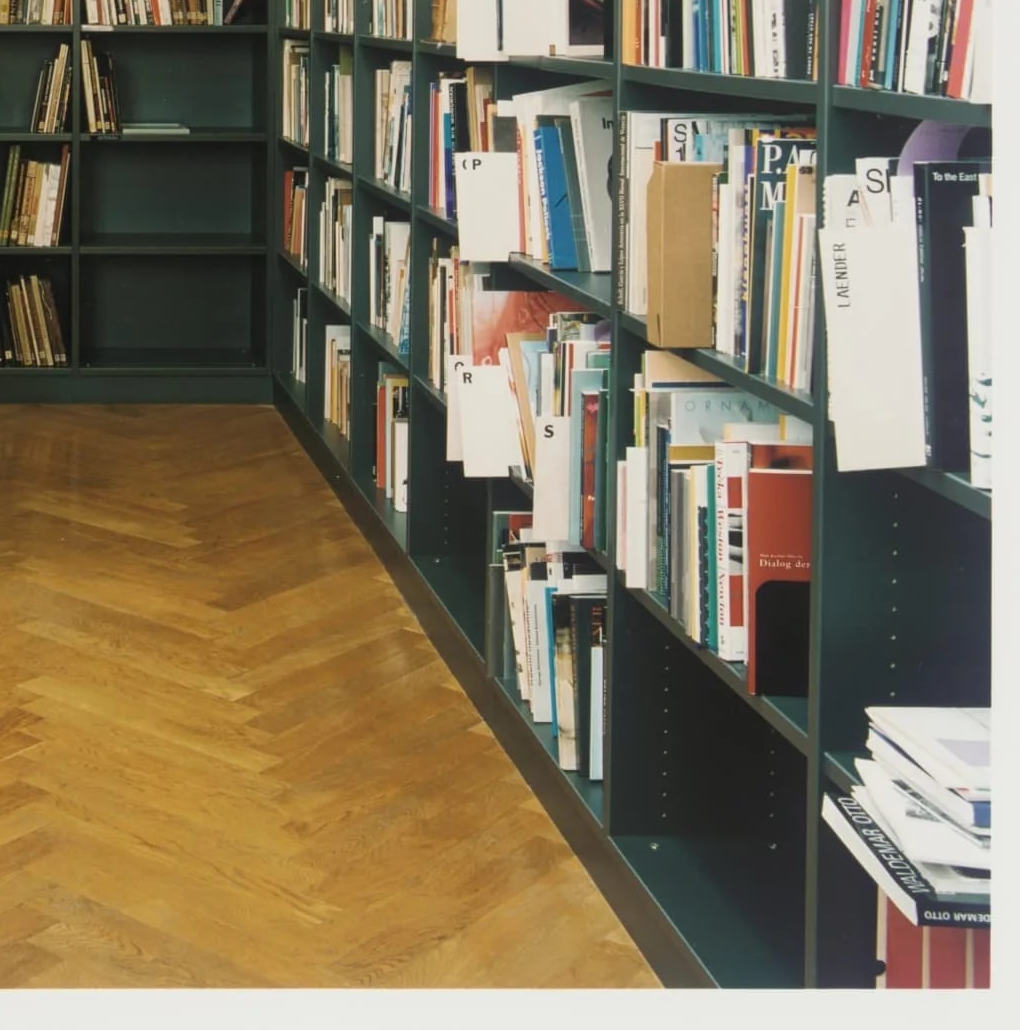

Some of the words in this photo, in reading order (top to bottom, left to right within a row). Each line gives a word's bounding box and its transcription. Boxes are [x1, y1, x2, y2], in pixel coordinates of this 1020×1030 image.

[472, 158, 482, 170] P
[932, 171, 943, 182] To
[944, 171, 958, 182] the
[959, 172, 978, 182] East
[832, 242, 851, 308] LAENDER
[462, 372, 472, 384] R
[543, 424, 555, 438] S
[759, 558, 791, 570] Dialog
[795, 558, 811, 569] der
[837, 796, 872, 825] OTTO
[862, 827, 930, 894] WALDEMAR
[923, 910, 951, 921] OTTO
